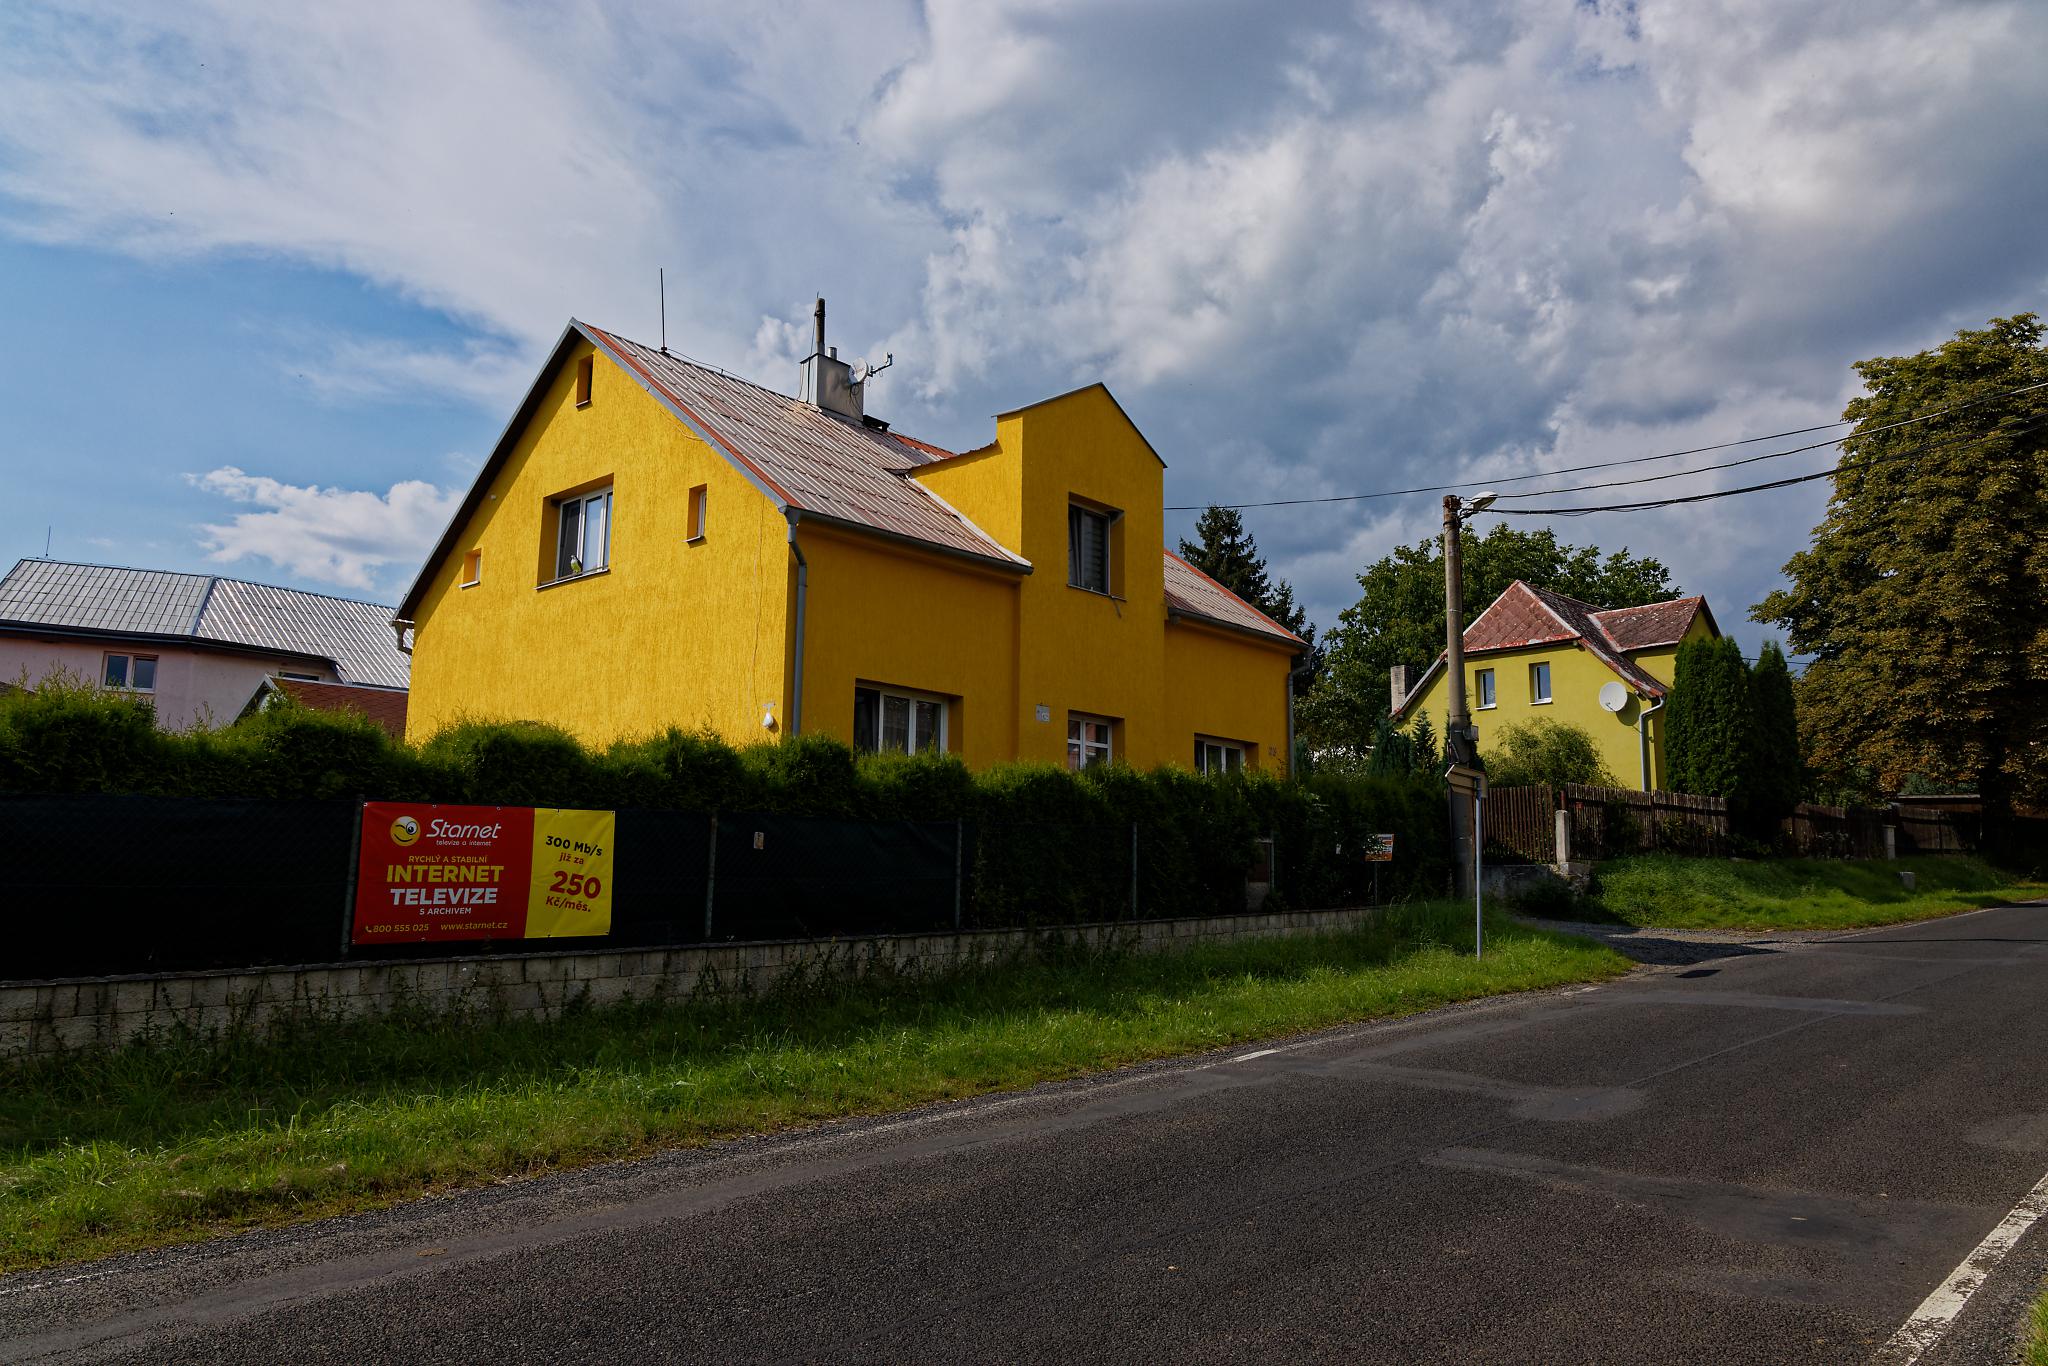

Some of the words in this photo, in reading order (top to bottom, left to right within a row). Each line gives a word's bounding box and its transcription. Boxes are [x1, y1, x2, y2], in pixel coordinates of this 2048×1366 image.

[426, 819, 502, 838] Starnet
[546, 836, 570, 849] 300
[574, 842, 602, 855] Mb/s
[408, 854, 441, 863] RYCHLÝ
[451, 855, 488, 863] STABILNÍ
[559, 852, 571, 862] již
[573, 857, 584, 865] za
[386, 865, 504, 883] INTERNET
[550, 871, 601, 899] 250
[390, 888, 498, 905] TELEVIZE
[546, 896, 590, 912] Kč/měs.
[427, 907, 472, 915] ARCHIVEM
[372, 924, 391, 933] 800
[393, 924, 410, 932] 555
[412, 924, 429, 932] 025
[440, 922, 508, 931] www.starnet.cz
